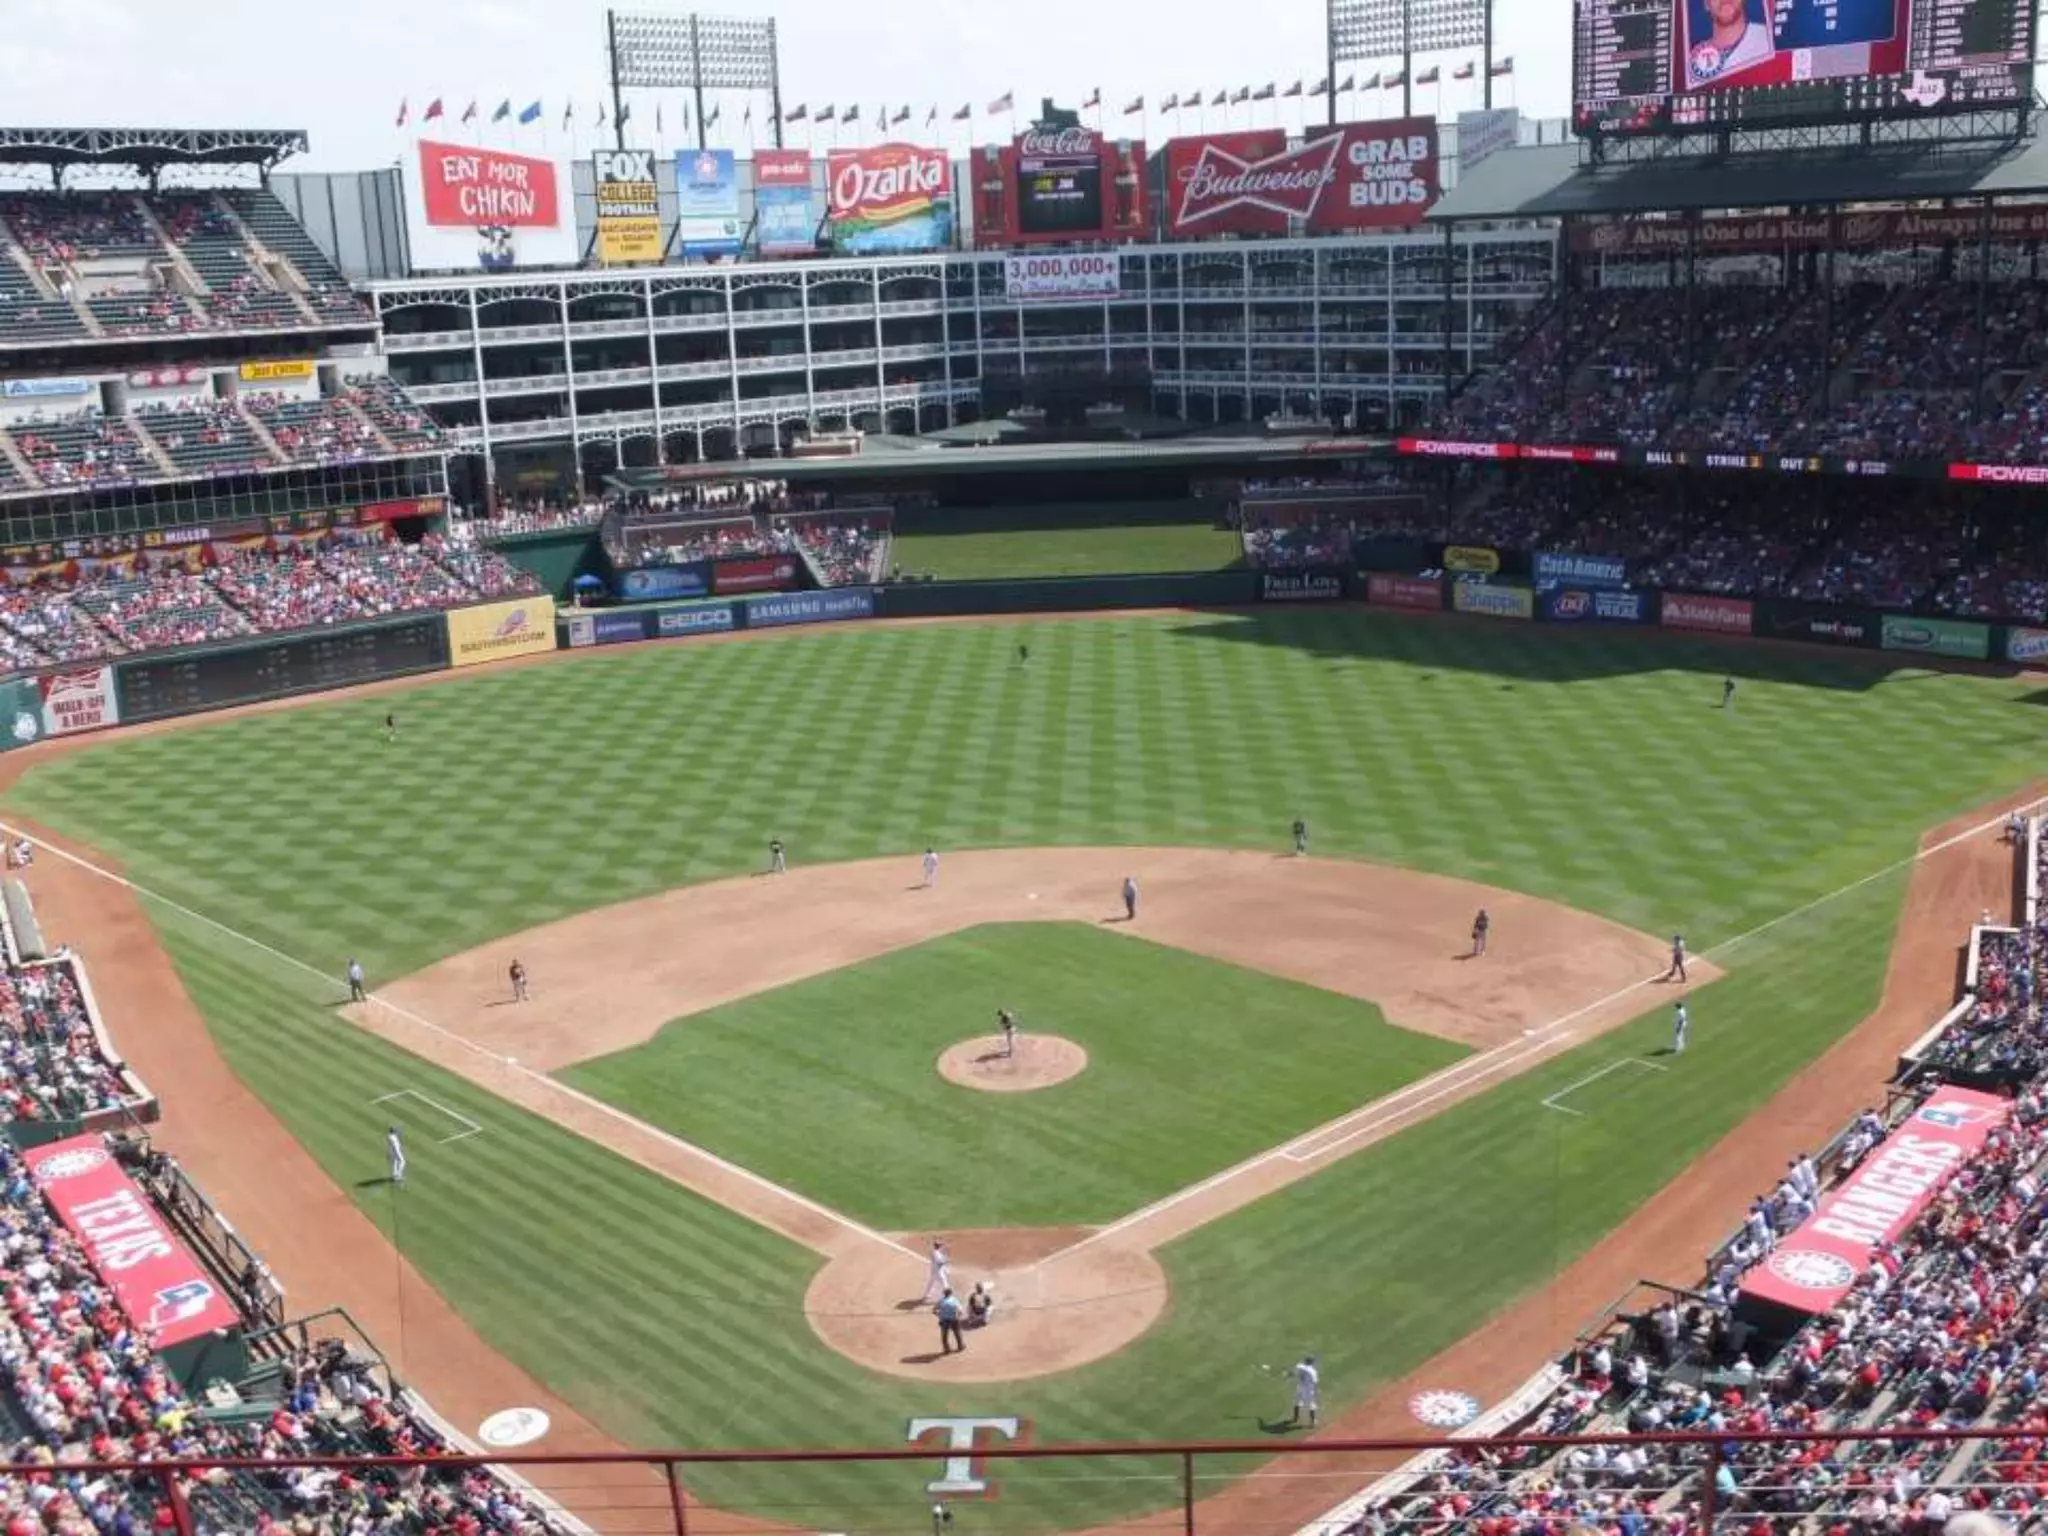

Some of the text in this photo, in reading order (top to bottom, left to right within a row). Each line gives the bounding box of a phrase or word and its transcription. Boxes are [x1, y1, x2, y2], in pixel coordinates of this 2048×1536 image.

[1021, 127, 1093, 155] Coca-Cola
[1349, 136, 1428, 165] GRAB
[441, 155, 529, 190] EAT MOR
[594, 152, 654, 182] FOX
[1362, 162, 1415, 182] SOME
[599, 184, 655, 201] COLLEGE
[835, 155, 942, 209] Ozarka
[1176, 161, 1337, 199] Budweiser
[460, 184, 535, 217] CHIKIN
[1349, 179, 1427, 207] BUDS
[1781, 217, 1829, 240] Kind
[1009, 257, 1115, 282] 3,000,000+
[1415, 441, 1500, 458] POWERADE
[1646, 452, 1673, 465] BALL
[1706, 455, 1746, 468] STRIKE
[1780, 458, 1803, 470] OUT
[165, 528, 210, 543] MILLER
[659, 608, 732, 630] GEICO
[750, 599, 819, 619] SAMSUNG
[1811, 621, 1865, 637] verizon
[1810, 1134, 1961, 1245] RANGERS
[68, 1189, 173, 1271] TEXAS
[906, 1415, 1022, 1498] T
